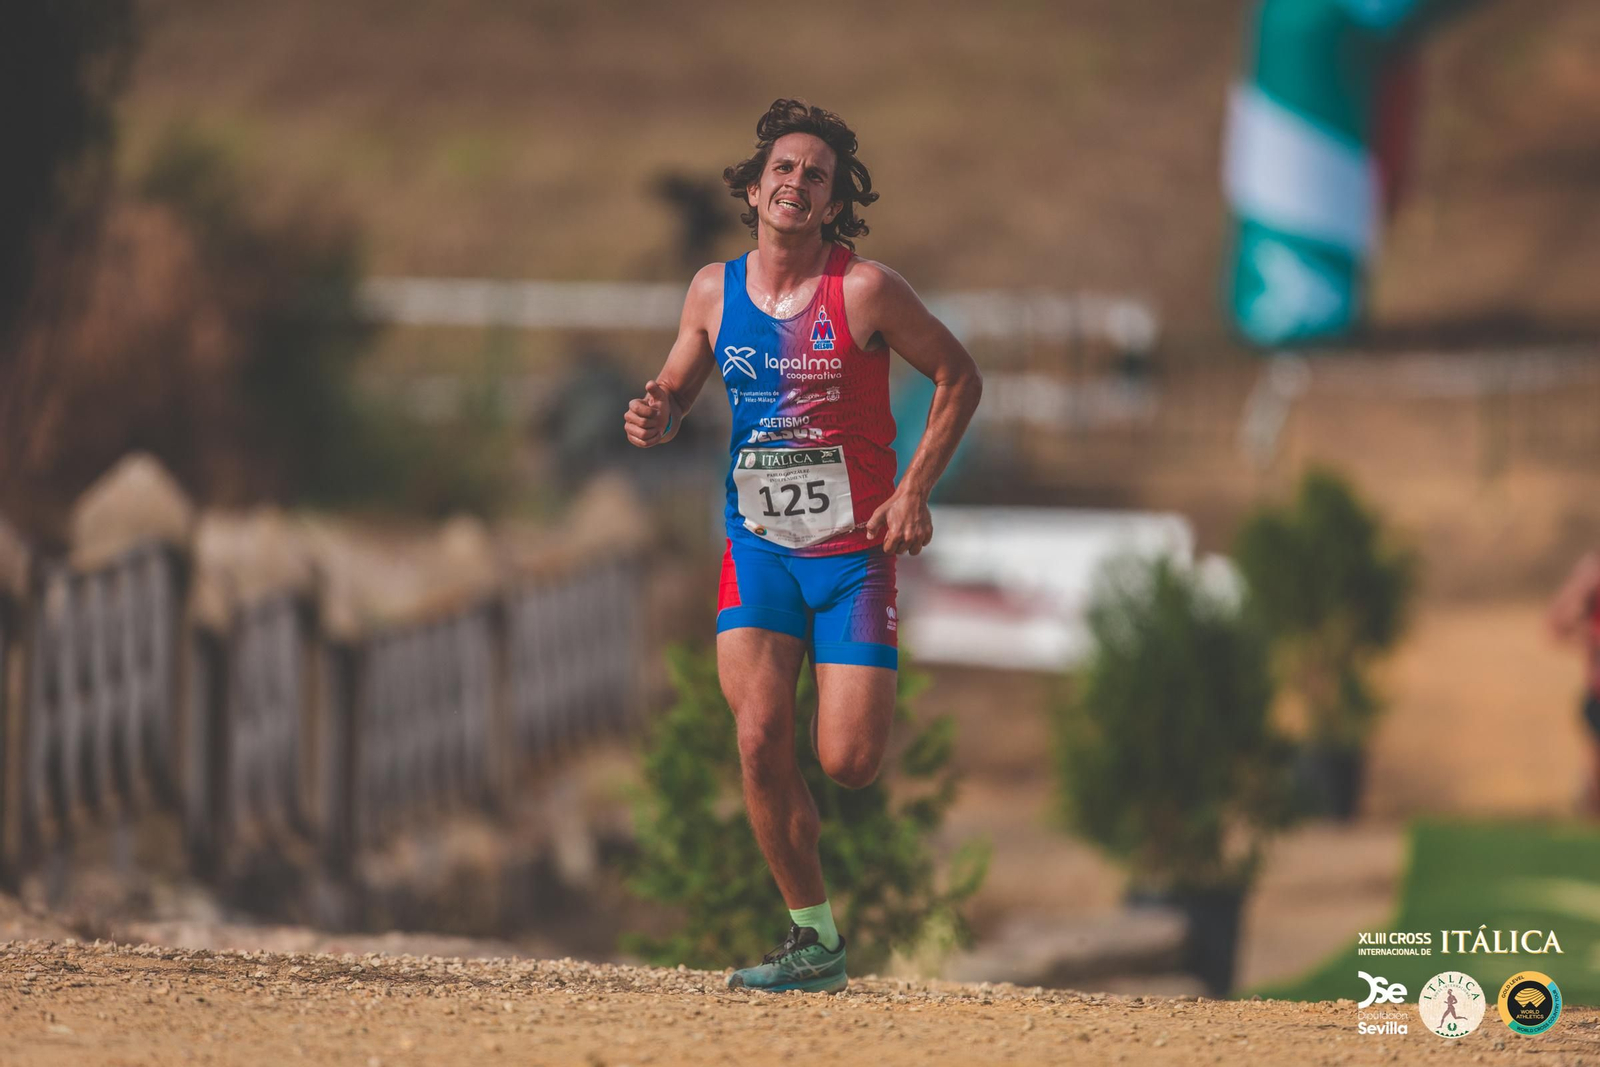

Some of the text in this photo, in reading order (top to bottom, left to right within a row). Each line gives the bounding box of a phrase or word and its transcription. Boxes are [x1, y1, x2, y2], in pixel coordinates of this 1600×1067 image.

[765, 353, 842, 375] lapalma
[786, 372, 842, 382] cooperativa
[761, 453, 813, 466] ITÁLICA
[759, 480, 830, 517] 125
